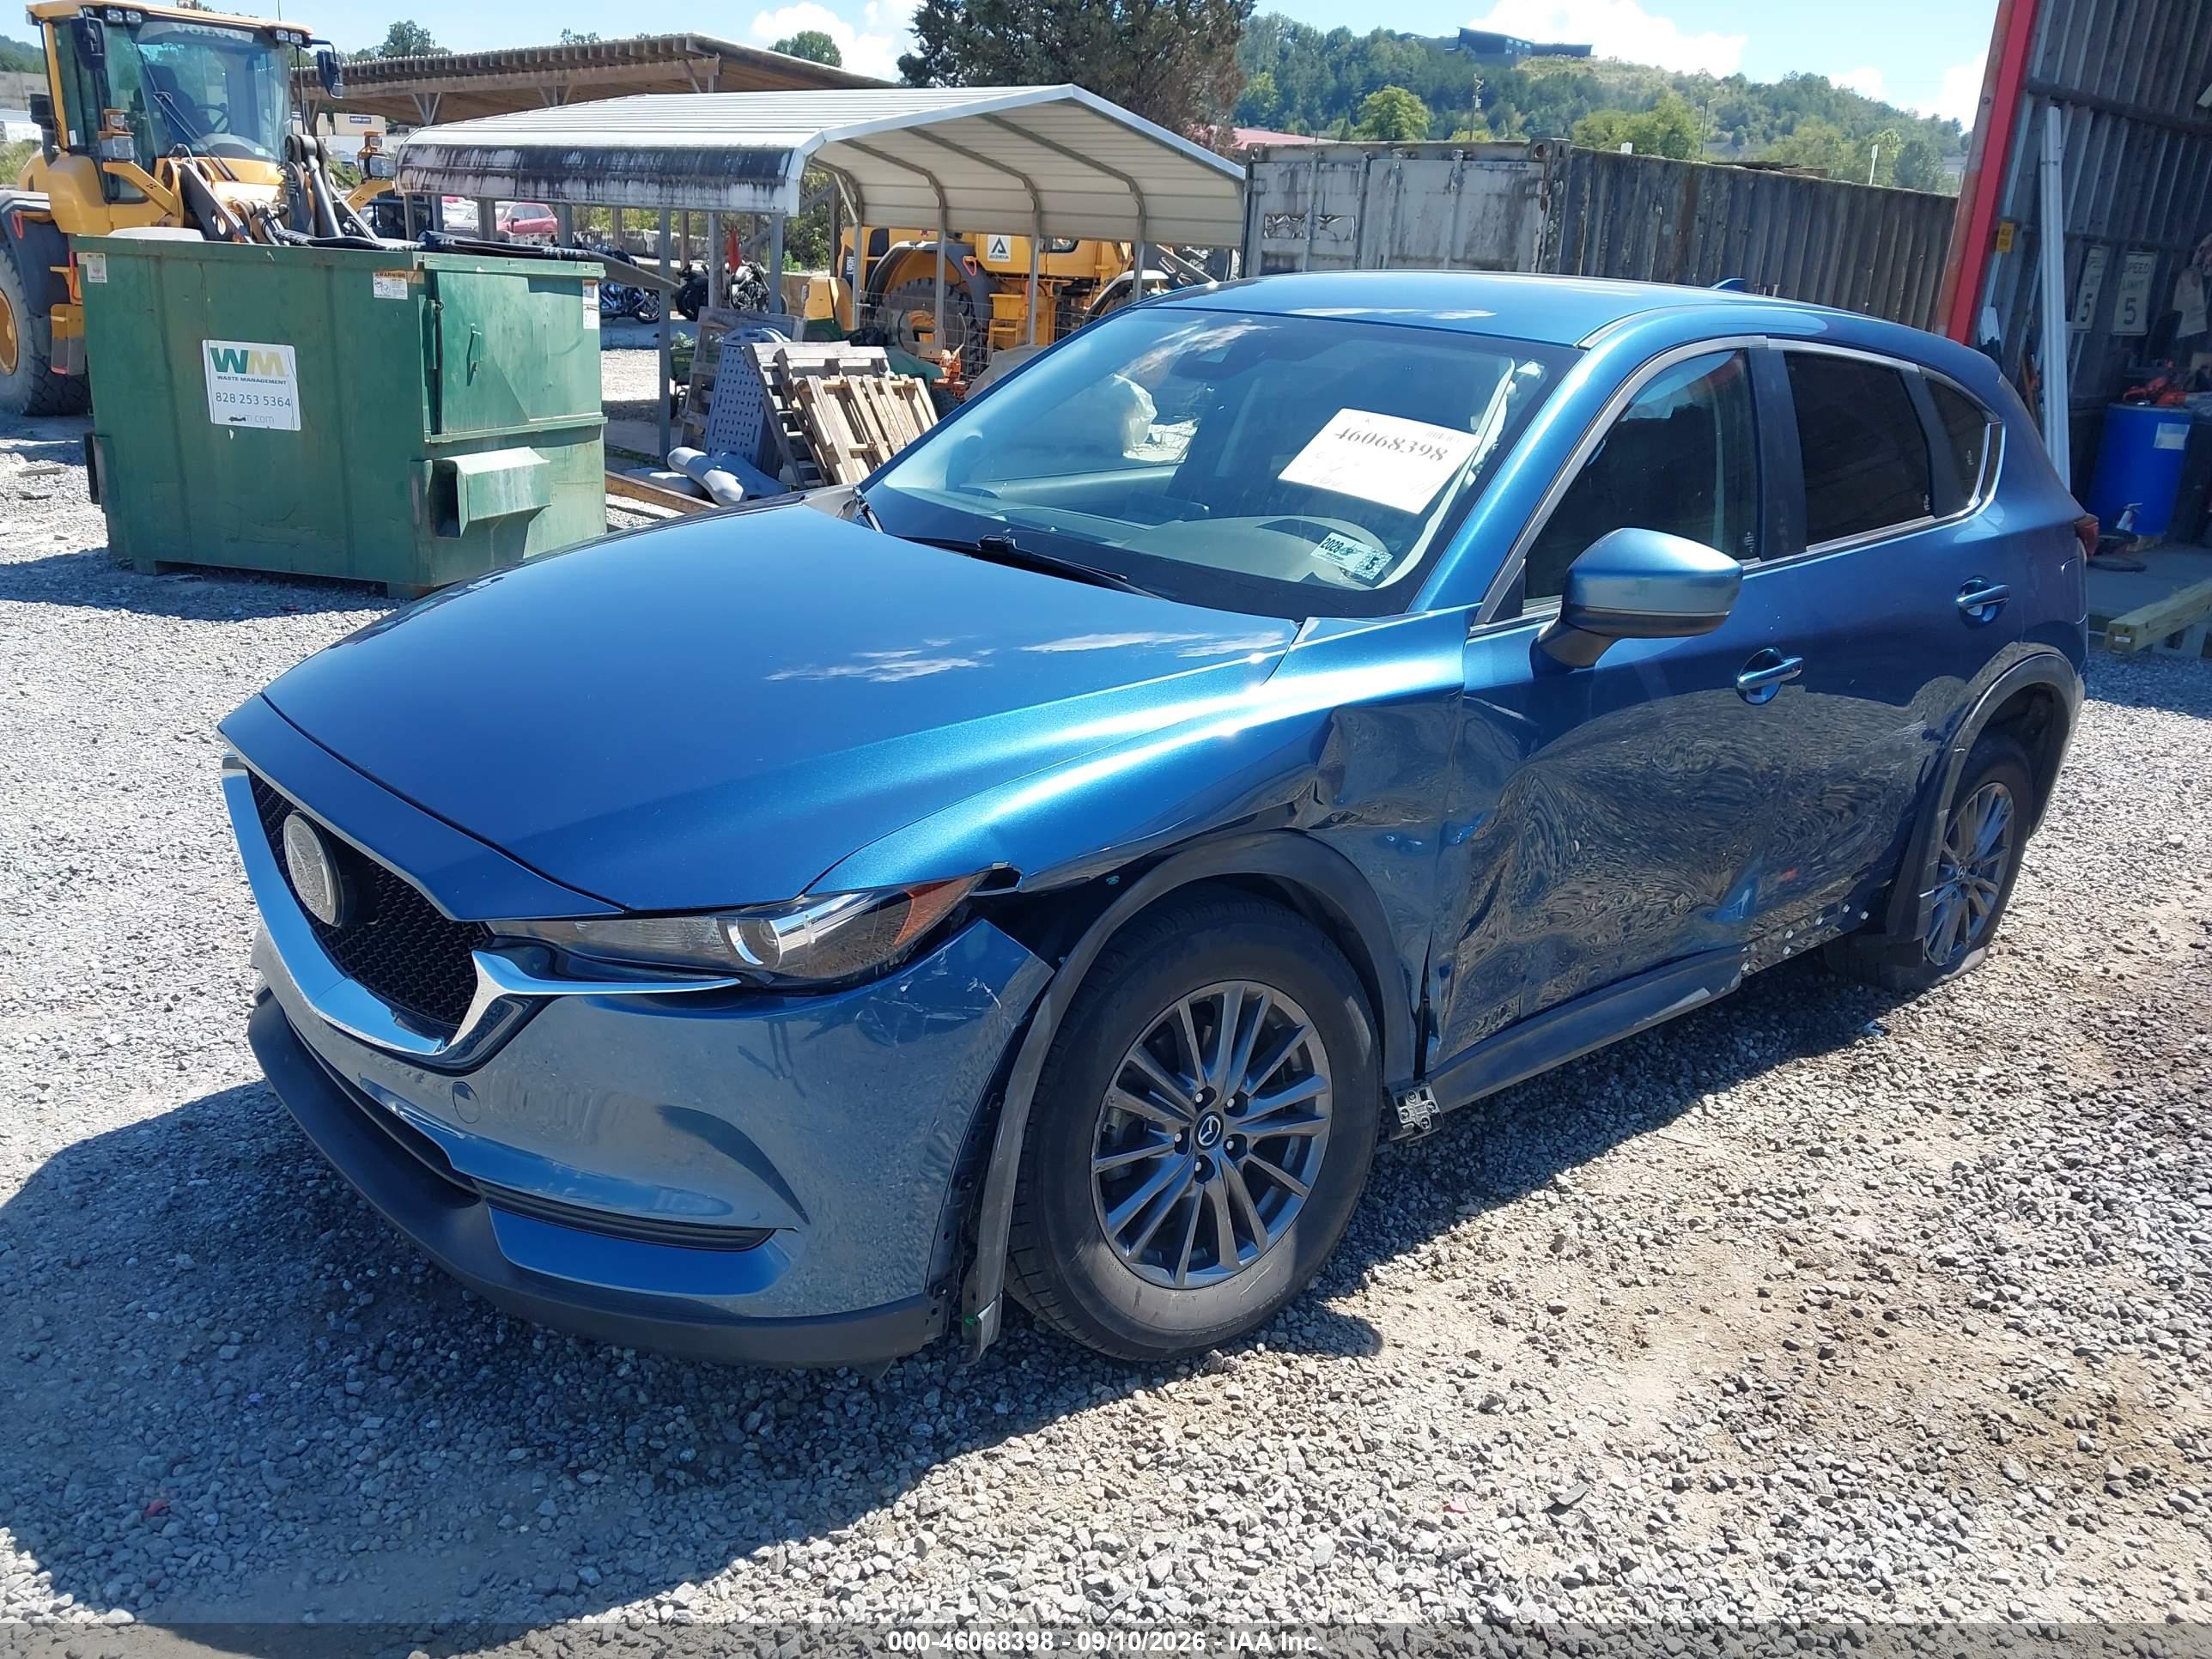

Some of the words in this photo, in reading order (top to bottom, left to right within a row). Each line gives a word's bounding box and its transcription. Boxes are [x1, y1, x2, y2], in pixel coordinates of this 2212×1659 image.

[2081, 293, 2093, 322] 5
[2124, 296, 2136, 325] 5
[210, 347, 286, 377] WM
[240, 376, 287, 385] MANAGEMENT
[216, 392, 236, 403] 828
[240, 393, 259, 404] 253
[263, 396, 291, 408] 5364
[1333, 427, 1449, 462] 46068398
[1320, 538, 1346, 554] 2028
[1365, 556, 1380, 571] 5
